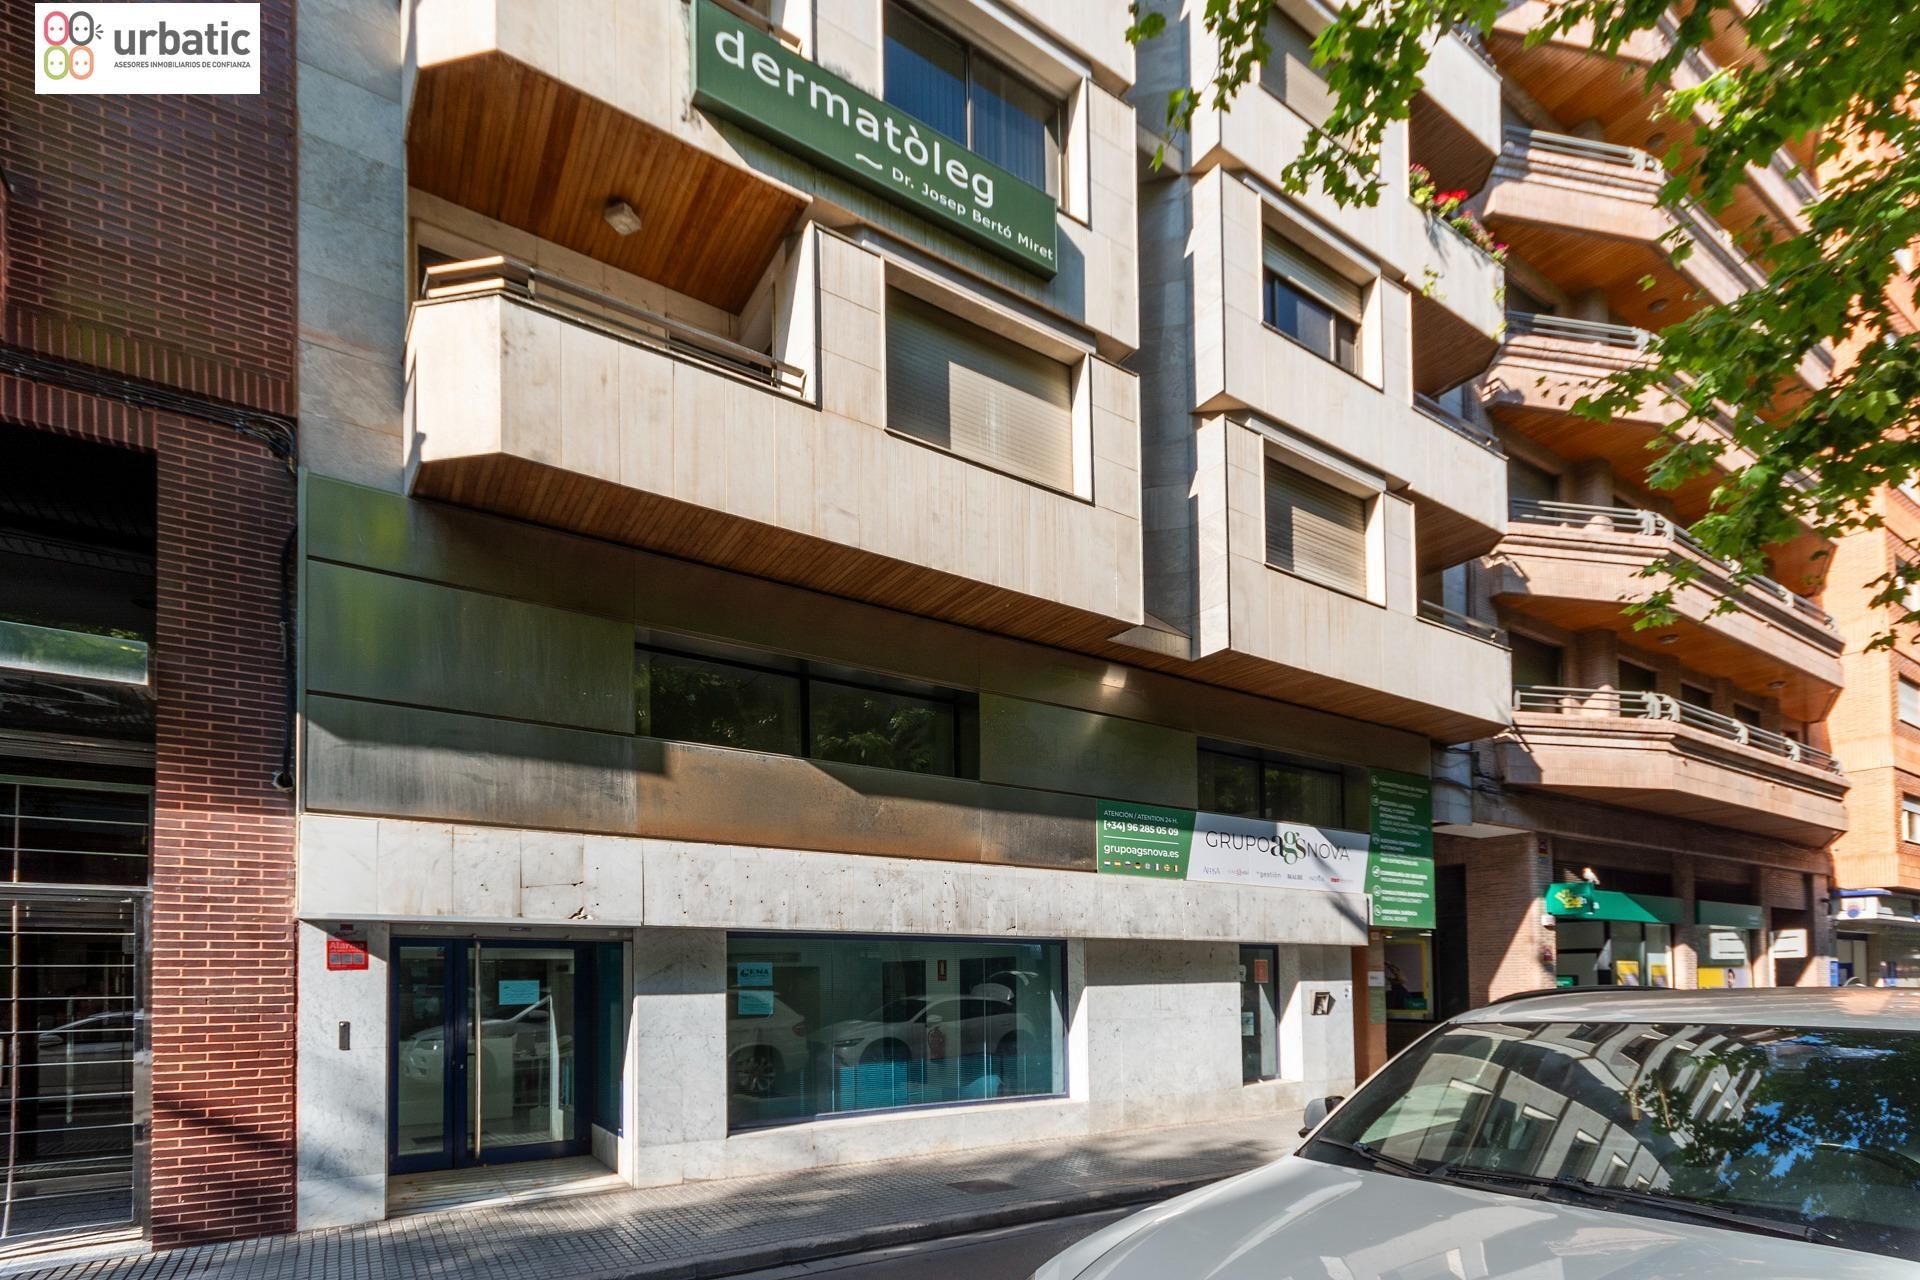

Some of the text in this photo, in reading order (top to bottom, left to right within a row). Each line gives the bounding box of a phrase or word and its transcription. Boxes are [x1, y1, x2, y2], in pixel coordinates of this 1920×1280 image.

[715, 30, 994, 208] dermatòleg
[892, 166, 1055, 261] Dr. Josep Bertó Miret
[1104, 845, 1180, 858] grupoagsnova.es
[1127, 823, 1138, 832] 96
[1140, 825, 1155, 834] 285
[1156, 826, 1167, 835] 05
[1168, 828, 1179, 836] 09
